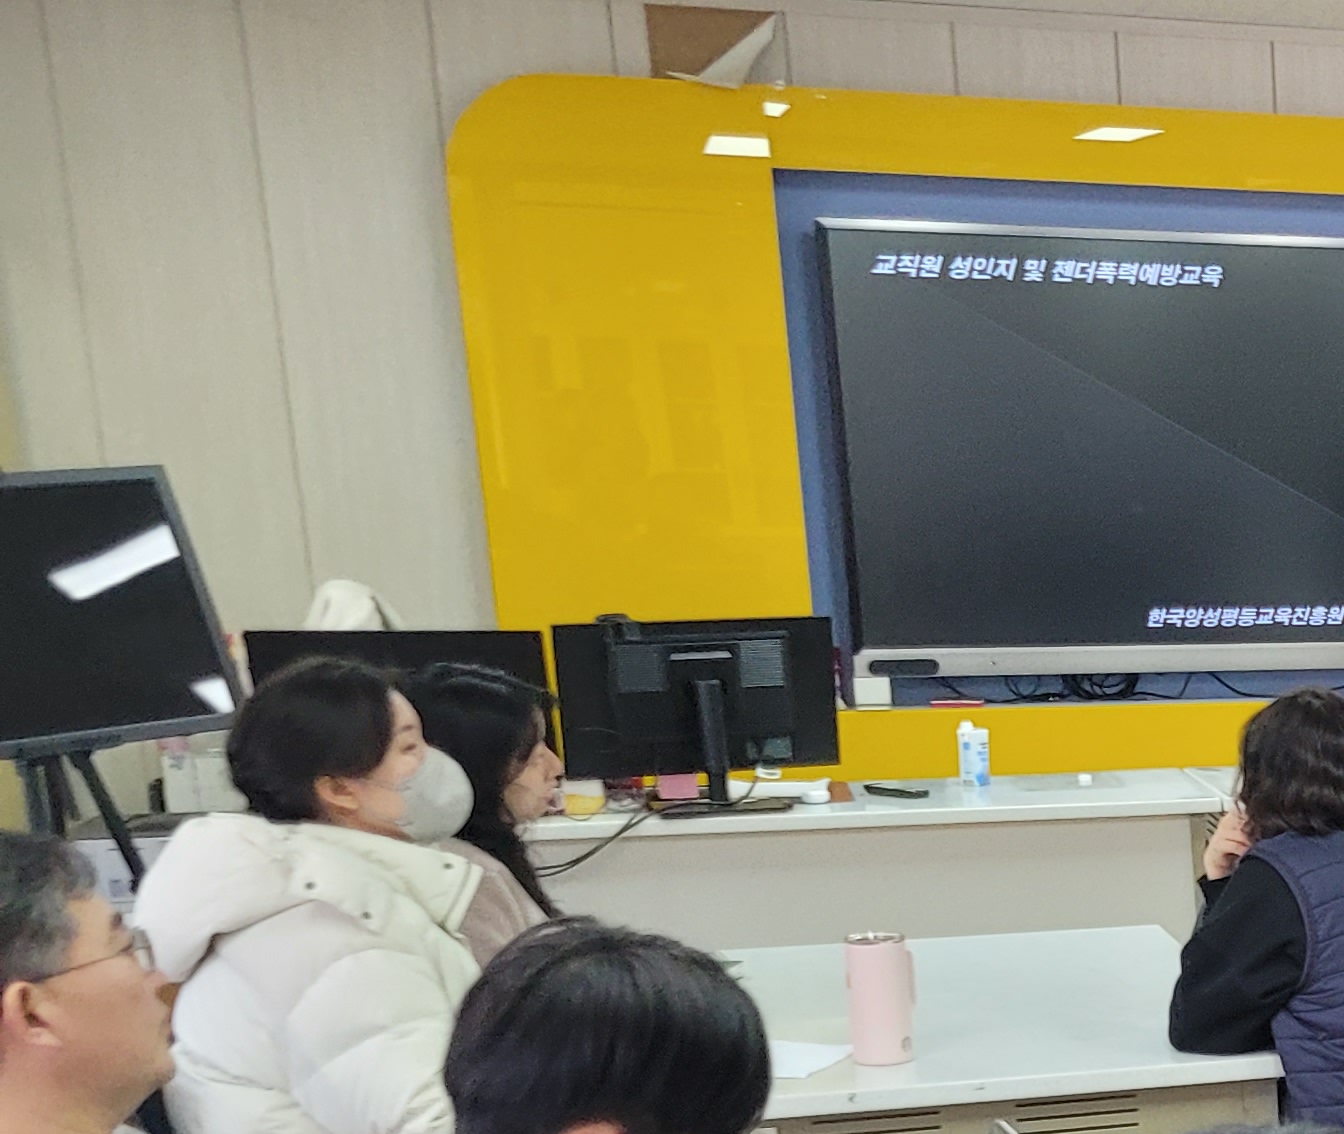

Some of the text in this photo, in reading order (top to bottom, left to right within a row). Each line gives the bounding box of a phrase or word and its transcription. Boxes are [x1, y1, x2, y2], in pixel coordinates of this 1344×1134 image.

[870, 254, 1225, 288] 교직원 성인지 및 젠더폭력예방교육
